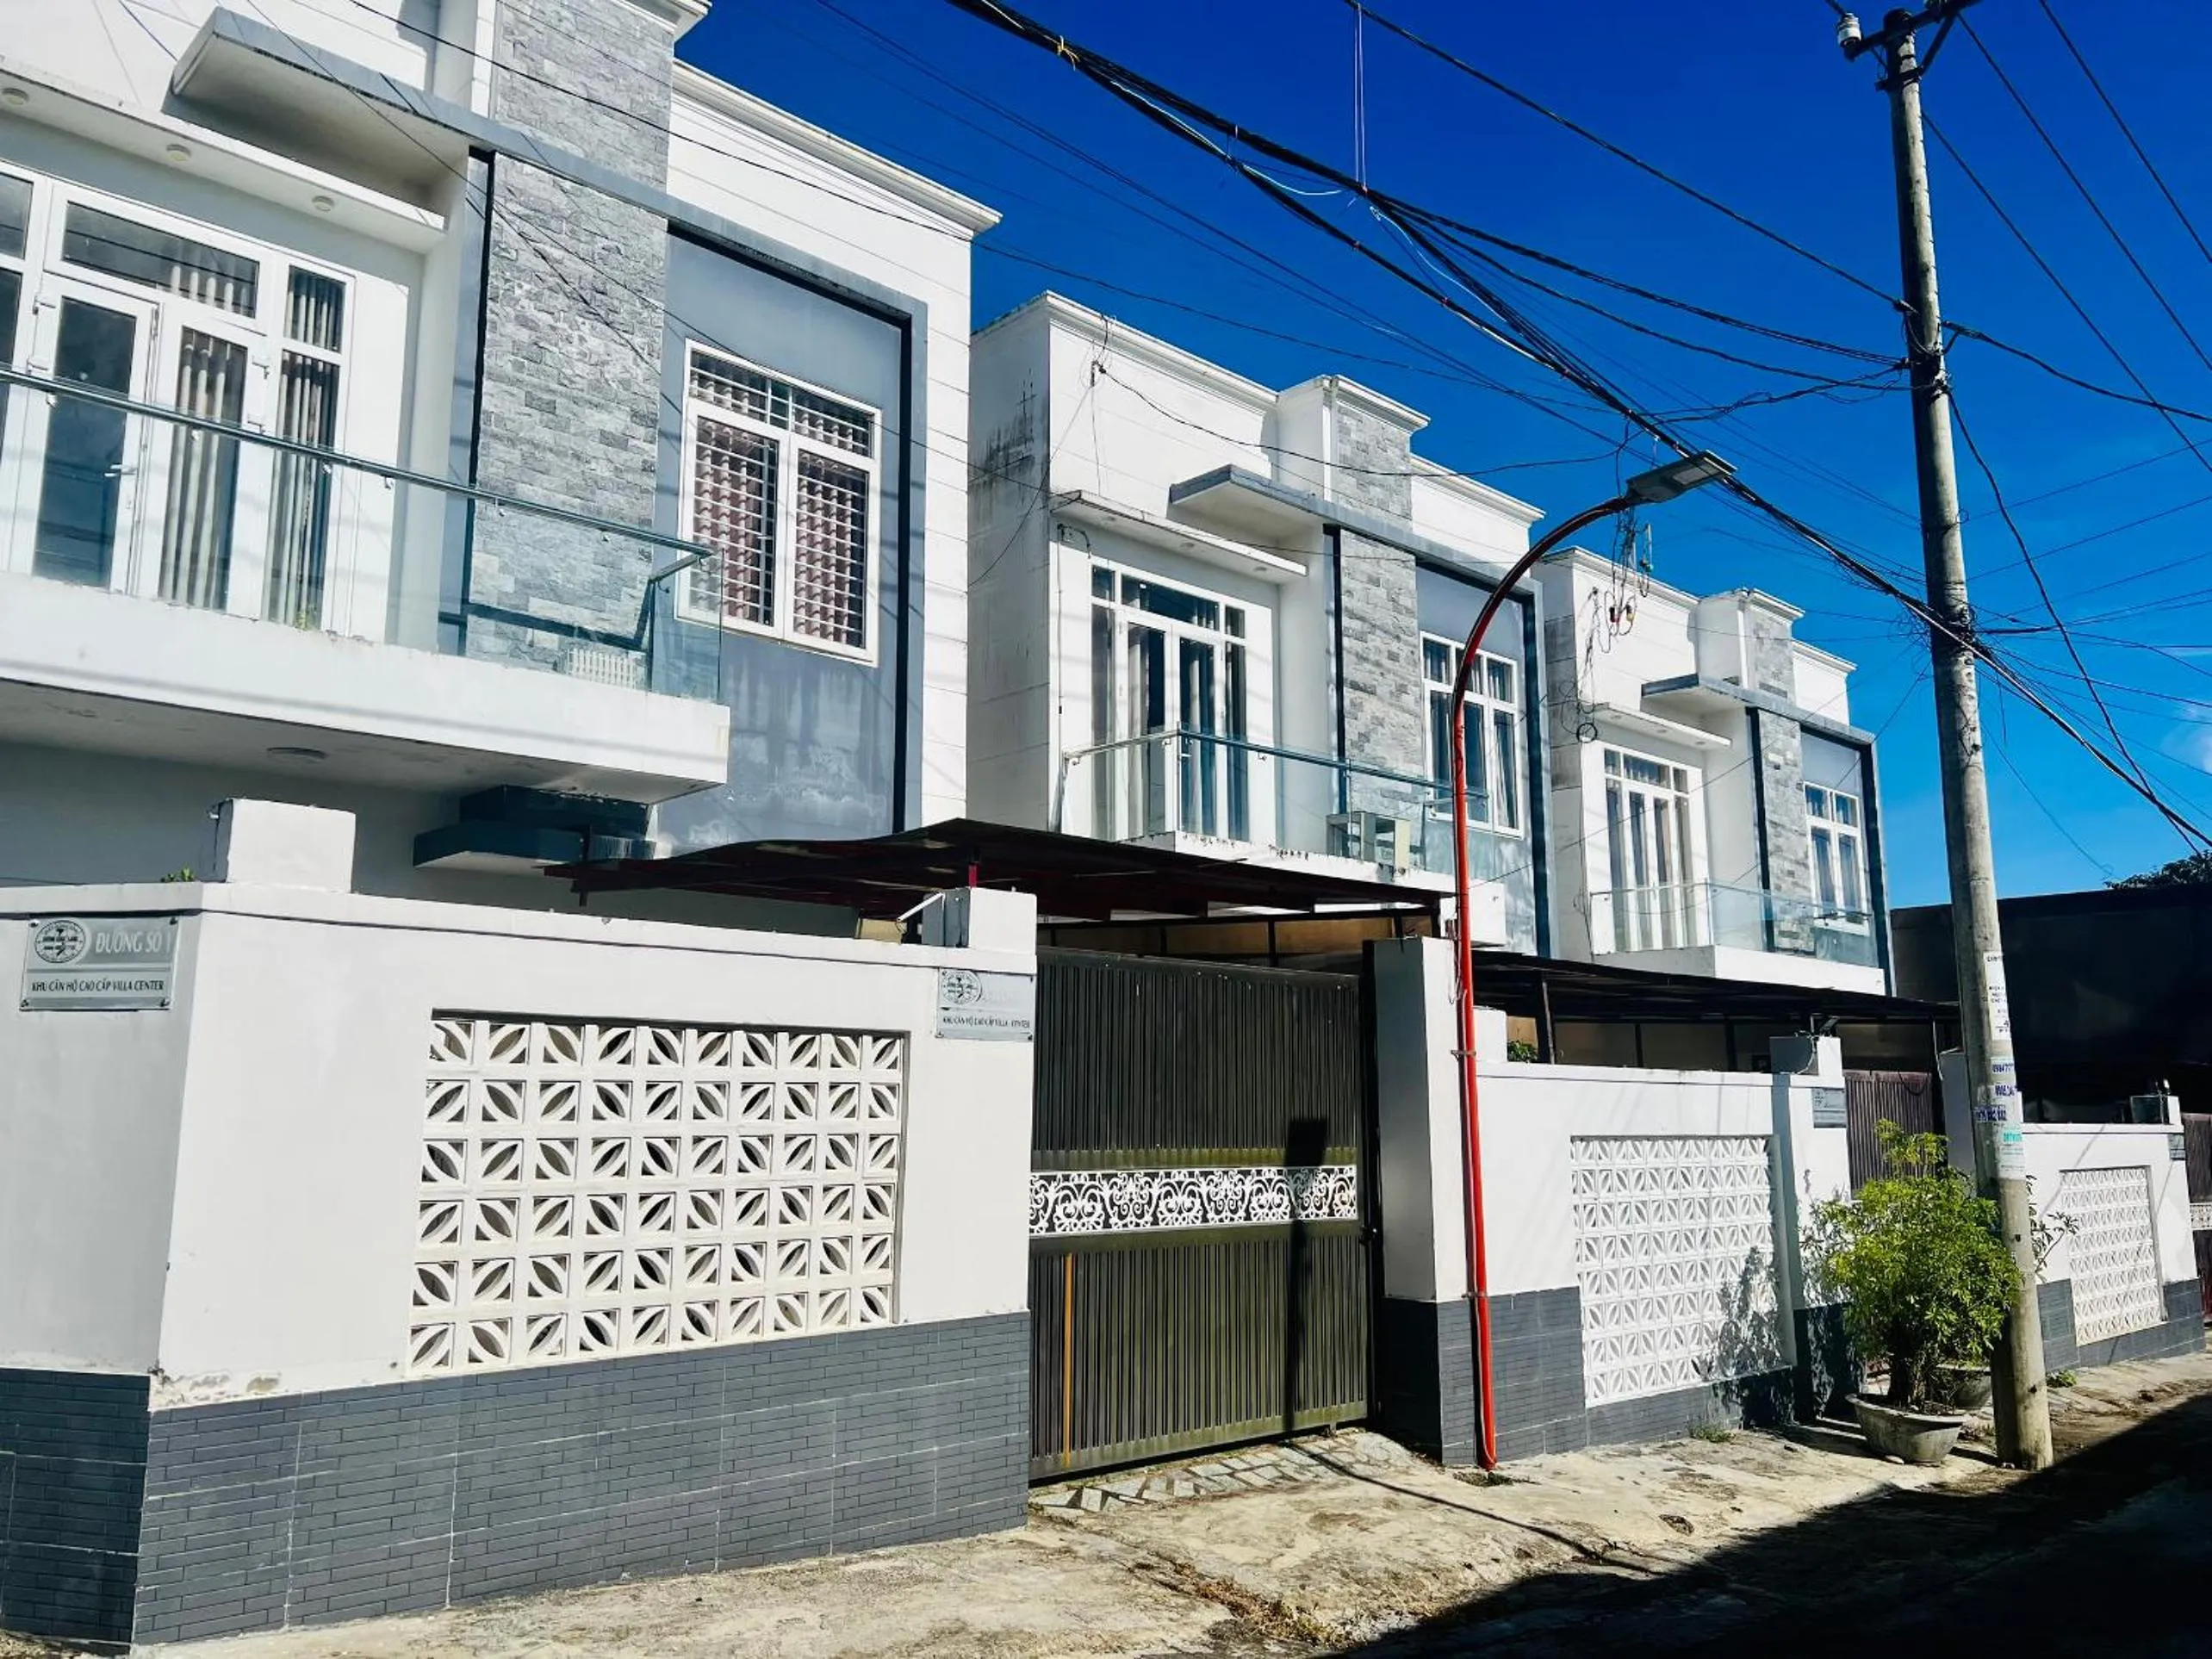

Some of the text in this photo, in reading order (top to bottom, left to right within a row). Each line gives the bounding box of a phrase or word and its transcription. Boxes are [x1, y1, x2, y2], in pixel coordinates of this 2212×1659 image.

[32, 980, 47, 991] KHU
[79, 980, 95, 991] CAO
[112, 980, 132, 991] VILLA
[134, 980, 165, 991] CENTER
